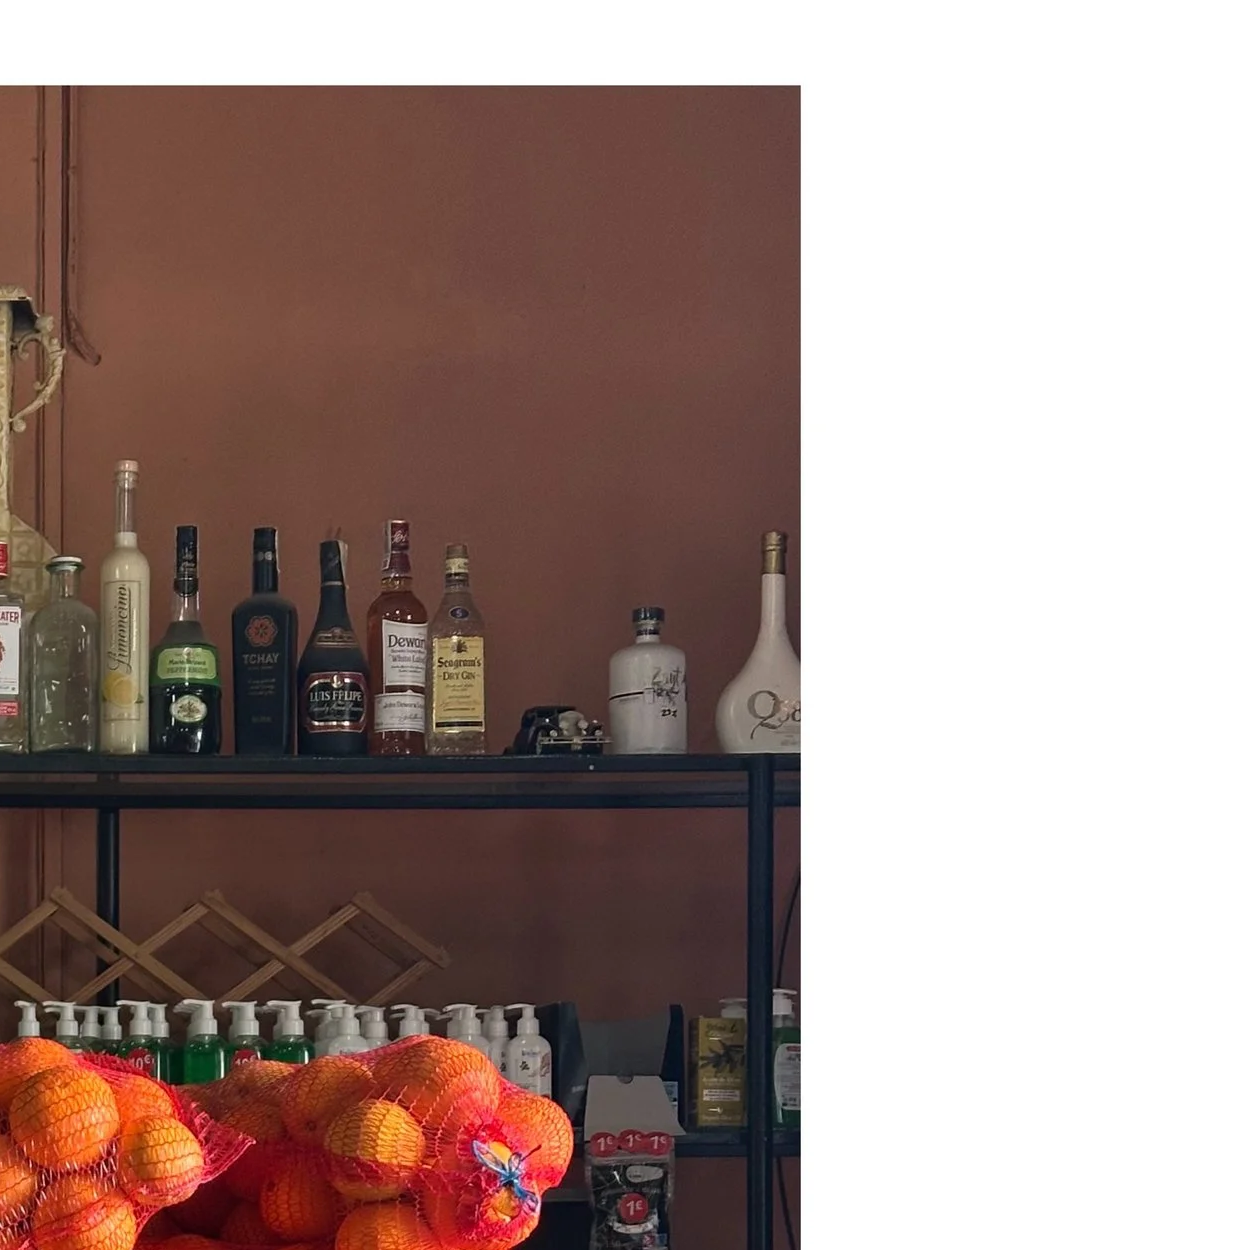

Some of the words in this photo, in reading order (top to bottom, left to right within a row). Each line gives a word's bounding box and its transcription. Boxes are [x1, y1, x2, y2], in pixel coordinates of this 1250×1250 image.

[107, 584, 132, 675] Limoncino
[242, 652, 280, 665] TCHAY
[437, 657, 482, 670] Seagram's
[442, 671, 460, 681] DRY
[460, 670, 476, 680] GIN
[310, 690, 330, 702] LUIS
[332, 690, 363, 702] FELIPE
[597, 1136, 613, 1152] 1€
[625, 1133, 642, 1148] 1€
[650, 1135, 667, 1149] 1€
[626, 1199, 644, 1215] 1€
